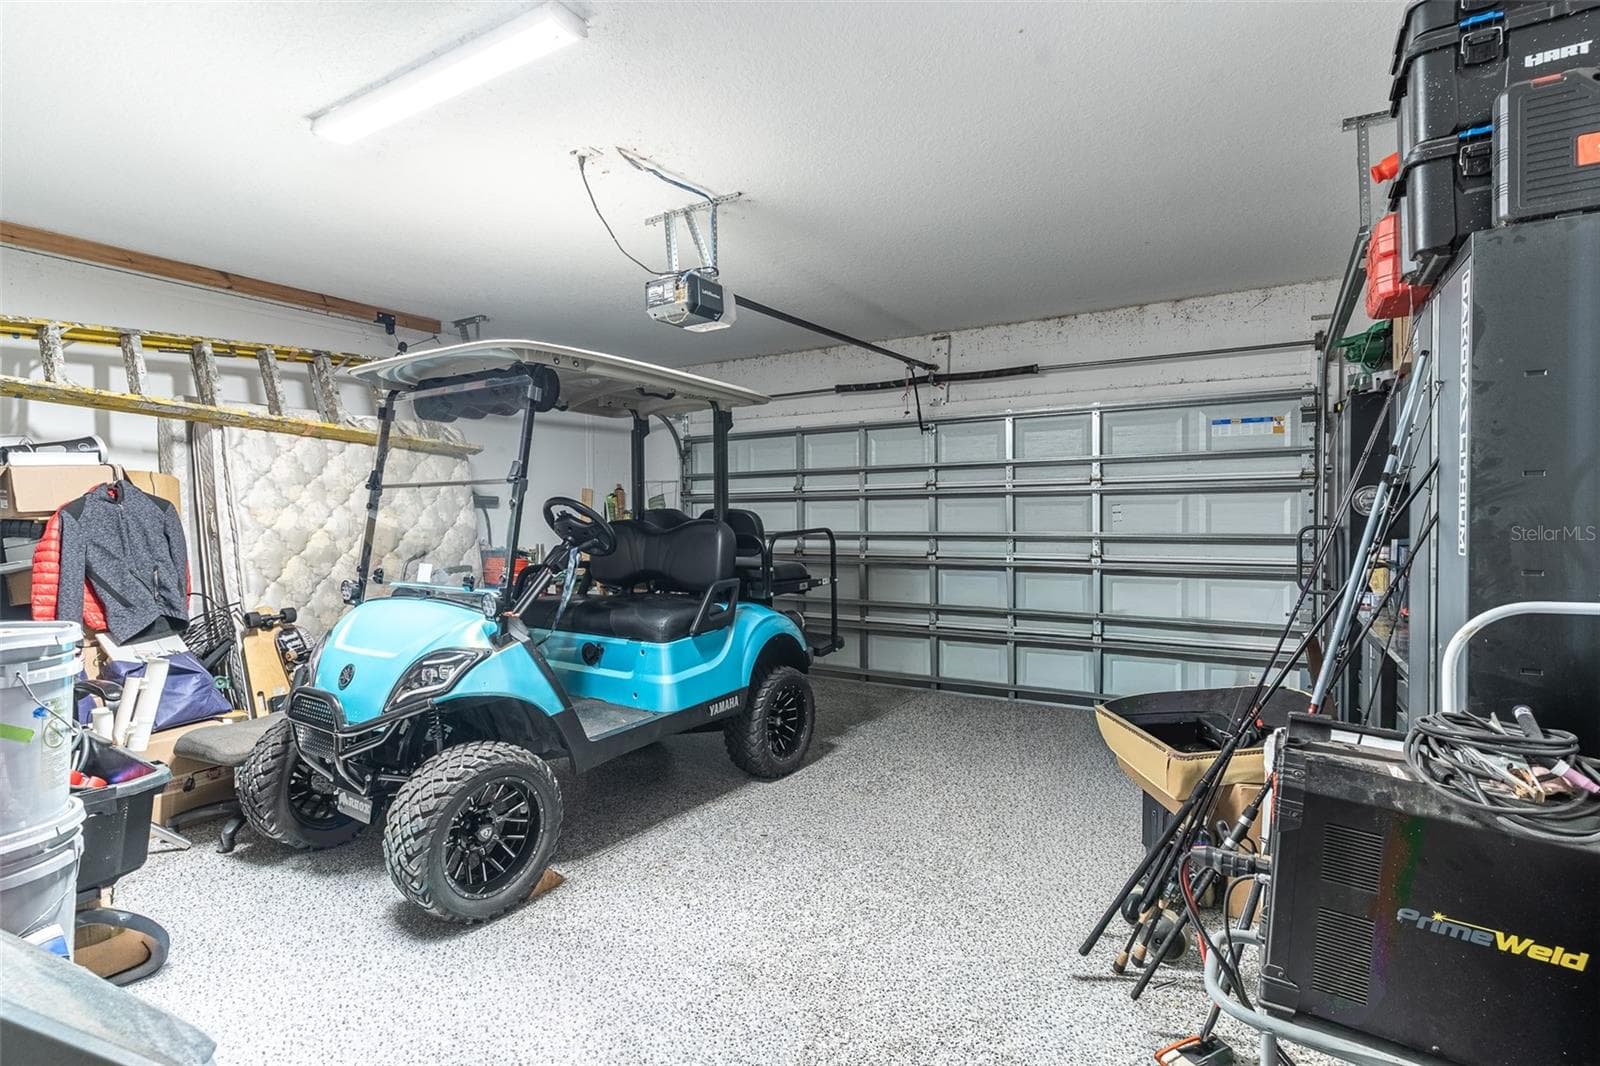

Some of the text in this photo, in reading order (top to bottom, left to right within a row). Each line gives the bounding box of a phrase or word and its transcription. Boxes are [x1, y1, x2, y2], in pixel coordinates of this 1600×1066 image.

[1524, 40, 1593, 67] HART
[709, 695, 739, 716] YAMAHA
[1396, 907, 1589, 972] PrimeWeld
